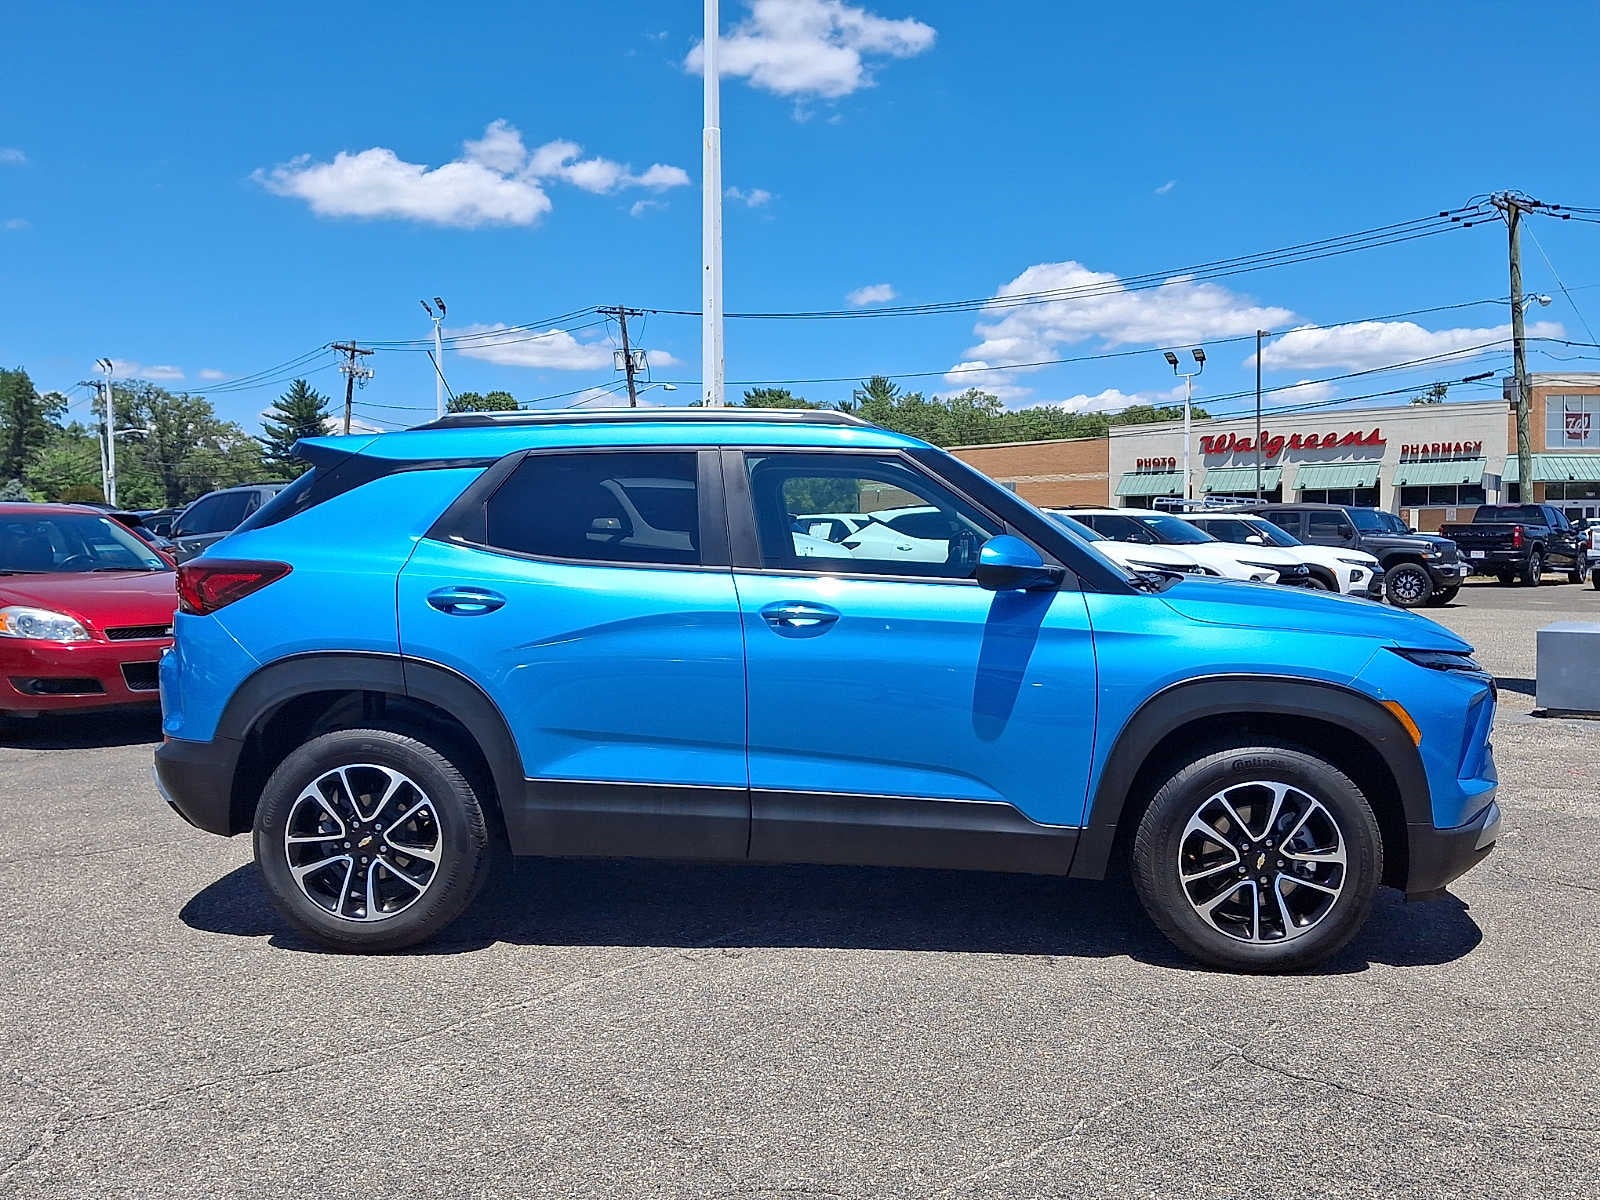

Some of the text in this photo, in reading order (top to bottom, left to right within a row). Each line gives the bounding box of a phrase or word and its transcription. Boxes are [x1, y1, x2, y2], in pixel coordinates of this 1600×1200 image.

[1200, 428, 1387, 459] Walgreens
[1401, 441, 1482, 455] PHARMACY
[1136, 456, 1176, 468] PHOTO
